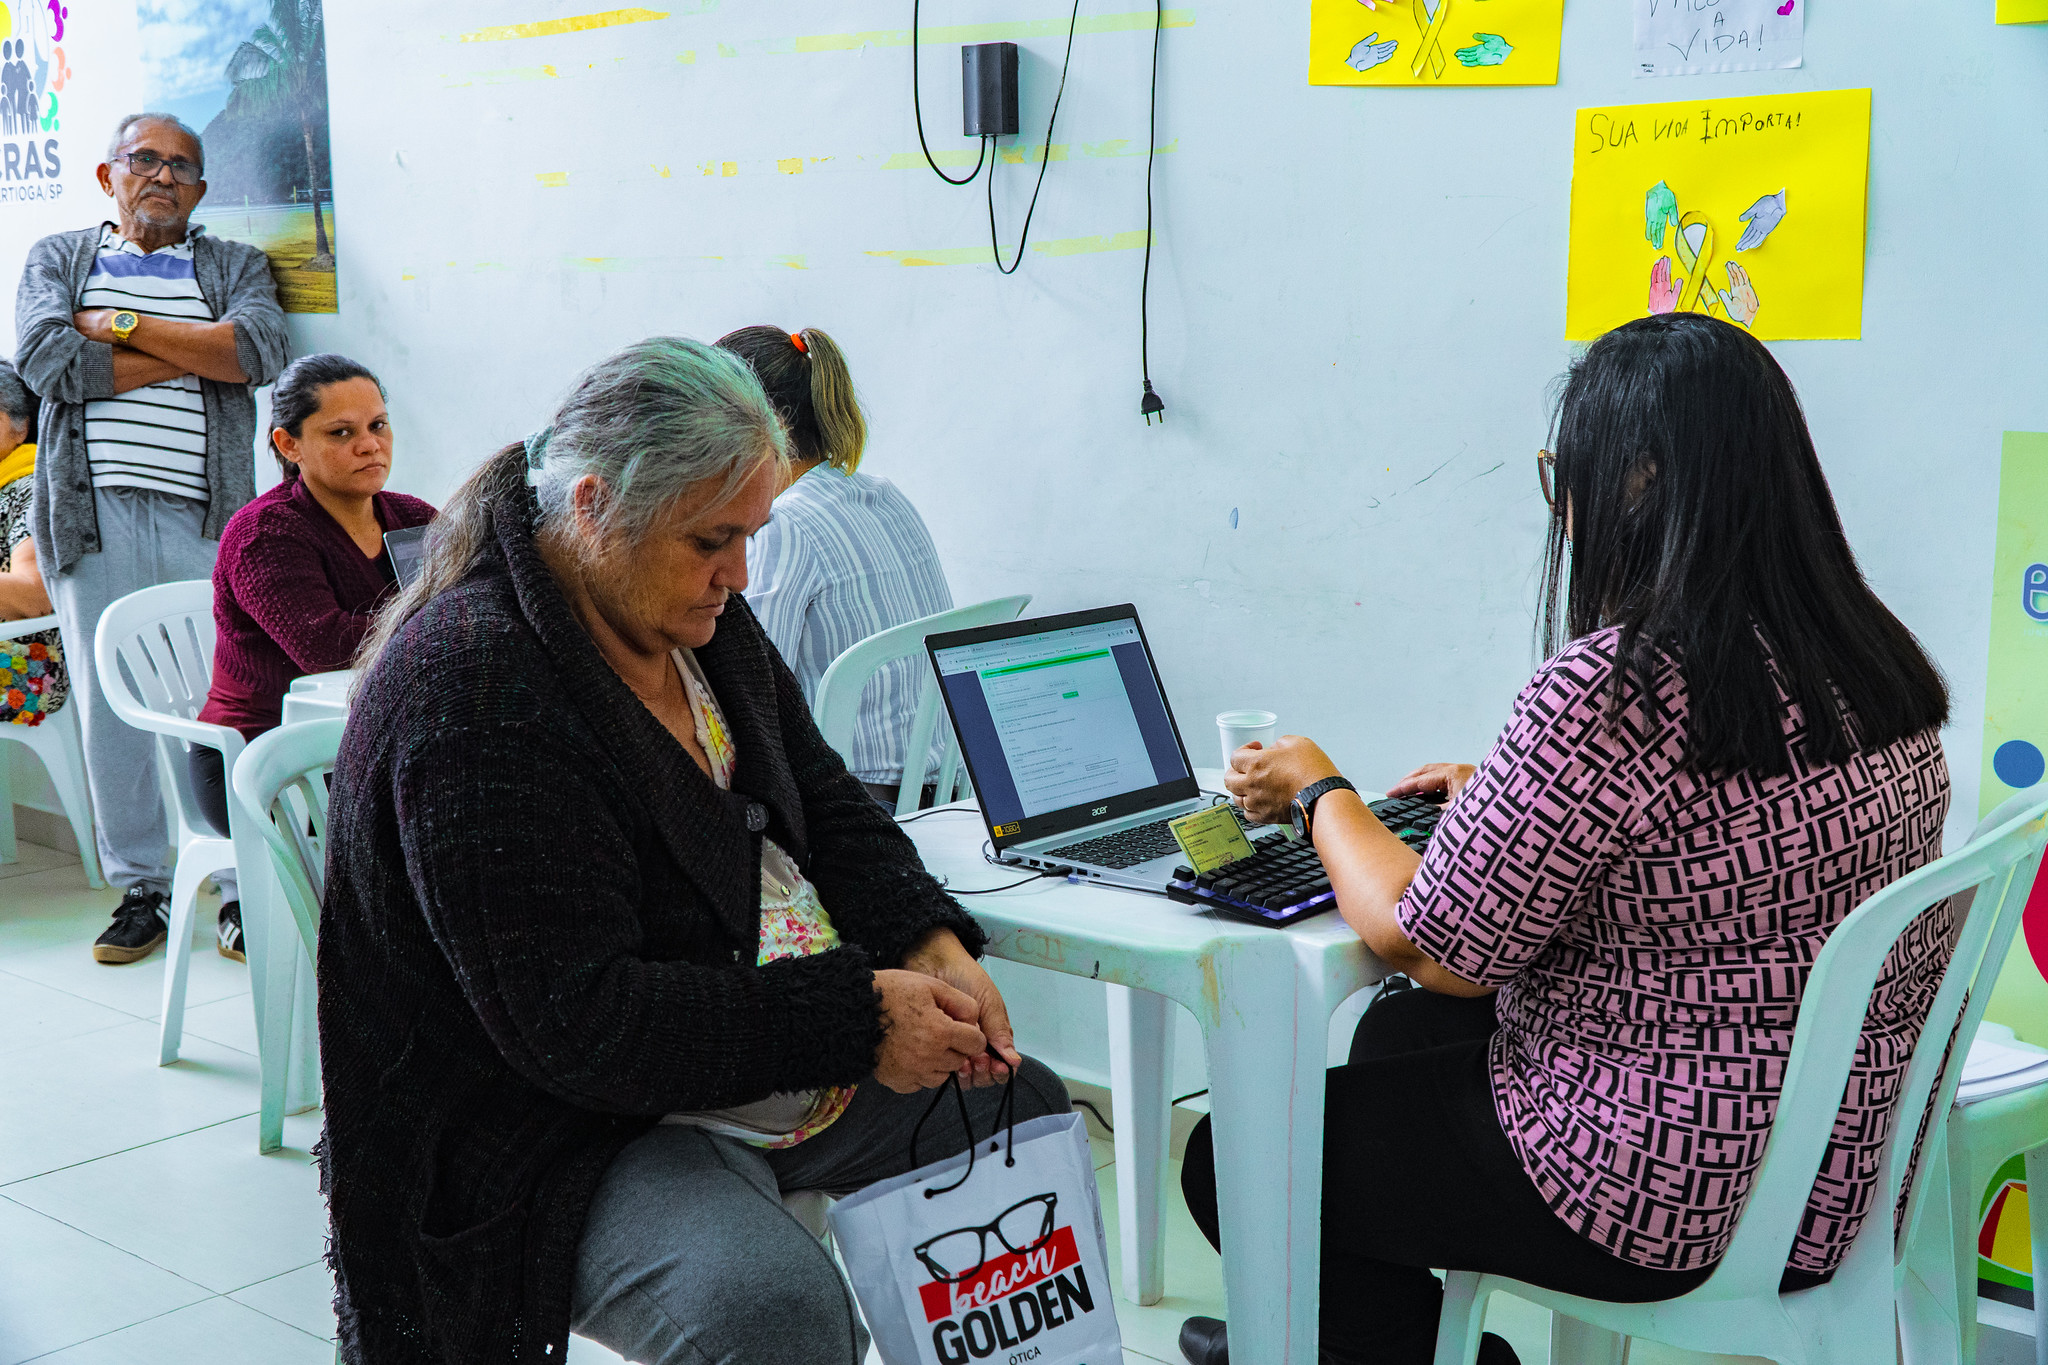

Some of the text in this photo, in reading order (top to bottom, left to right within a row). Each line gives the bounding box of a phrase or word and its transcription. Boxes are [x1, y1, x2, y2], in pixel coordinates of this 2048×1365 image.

[1713, 11, 1725, 28] A
[1667, 24, 1764, 61] VIDA!
[1590, 113, 1638, 154] SUA
[1654, 118, 1689, 141] VIDA
[0, 138, 61, 181] RAS
[0, 183, 63, 202] RTIOGA/SP
[1091, 805, 1108, 817] acer
[949, 1239, 1057, 1316] beach
[932, 1264, 1095, 1365] GOLDEN
